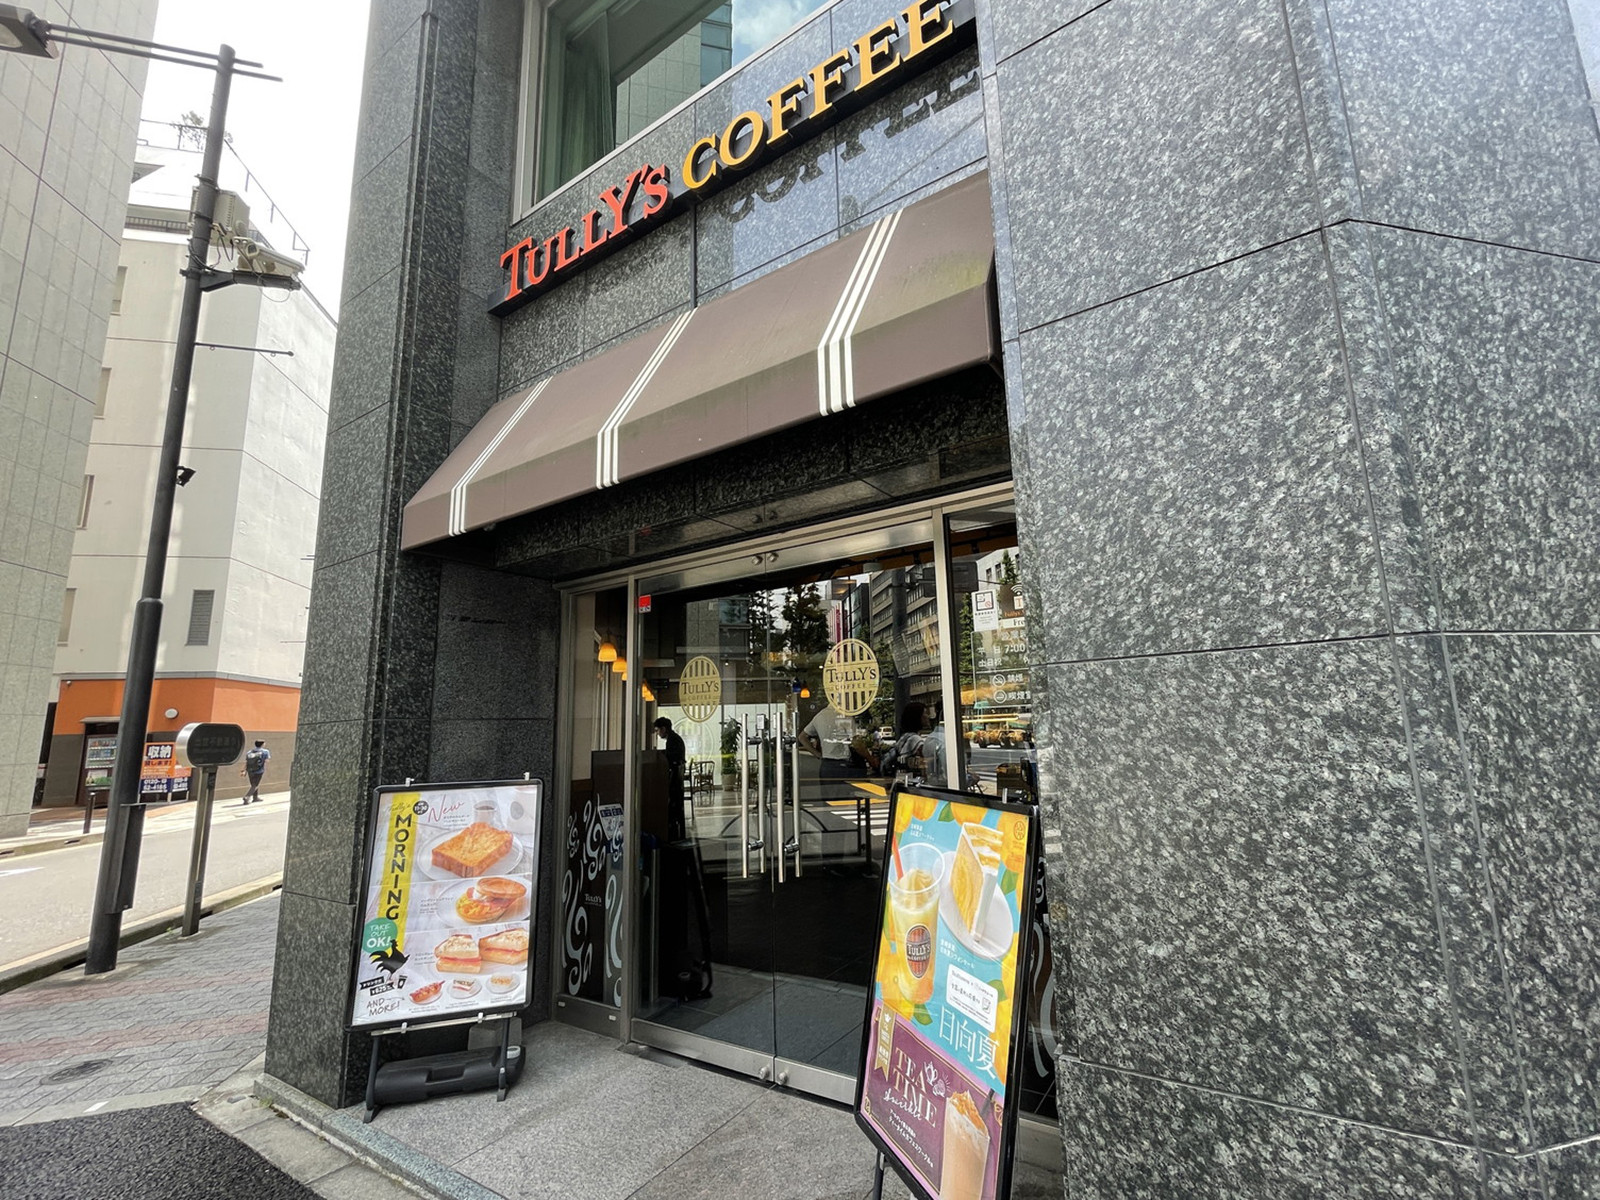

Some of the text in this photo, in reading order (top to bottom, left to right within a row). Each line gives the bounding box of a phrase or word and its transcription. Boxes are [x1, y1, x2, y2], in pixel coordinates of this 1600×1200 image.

[500, 0, 953, 301] TULLY'S COFFEE
[147, 744, 172, 759] 収納
[427, 794, 464, 823] New
[386, 814, 412, 920] MORNING
[370, 923, 391, 931] TAKE
[366, 937, 391, 948] OK!
[367, 998, 385, 1008] AND
[369, 1001, 400, 1016] MORE!
[939, 1005, 1000, 1080] 日向夏
[895, 1047, 928, 1095] TEA
[892, 1069, 937, 1128] TIME
